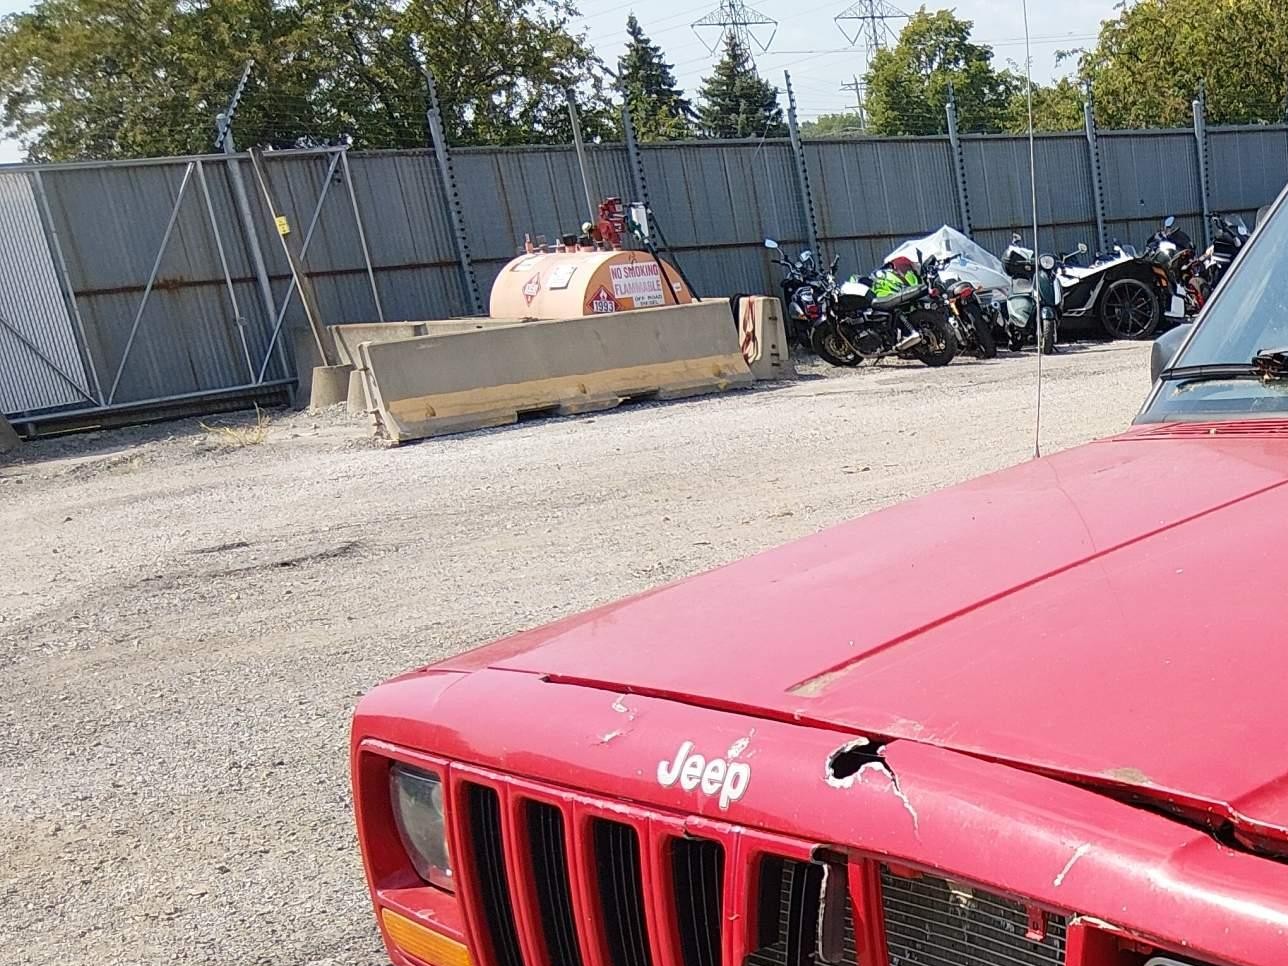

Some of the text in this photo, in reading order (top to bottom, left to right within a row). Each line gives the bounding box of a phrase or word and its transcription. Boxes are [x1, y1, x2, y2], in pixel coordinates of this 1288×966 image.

[611, 264, 658, 280] NO SMOKING
[615, 280, 661, 294] FLAMMABLE
[594, 301, 614, 312] 1993
[657, 740, 751, 811] Jeep
